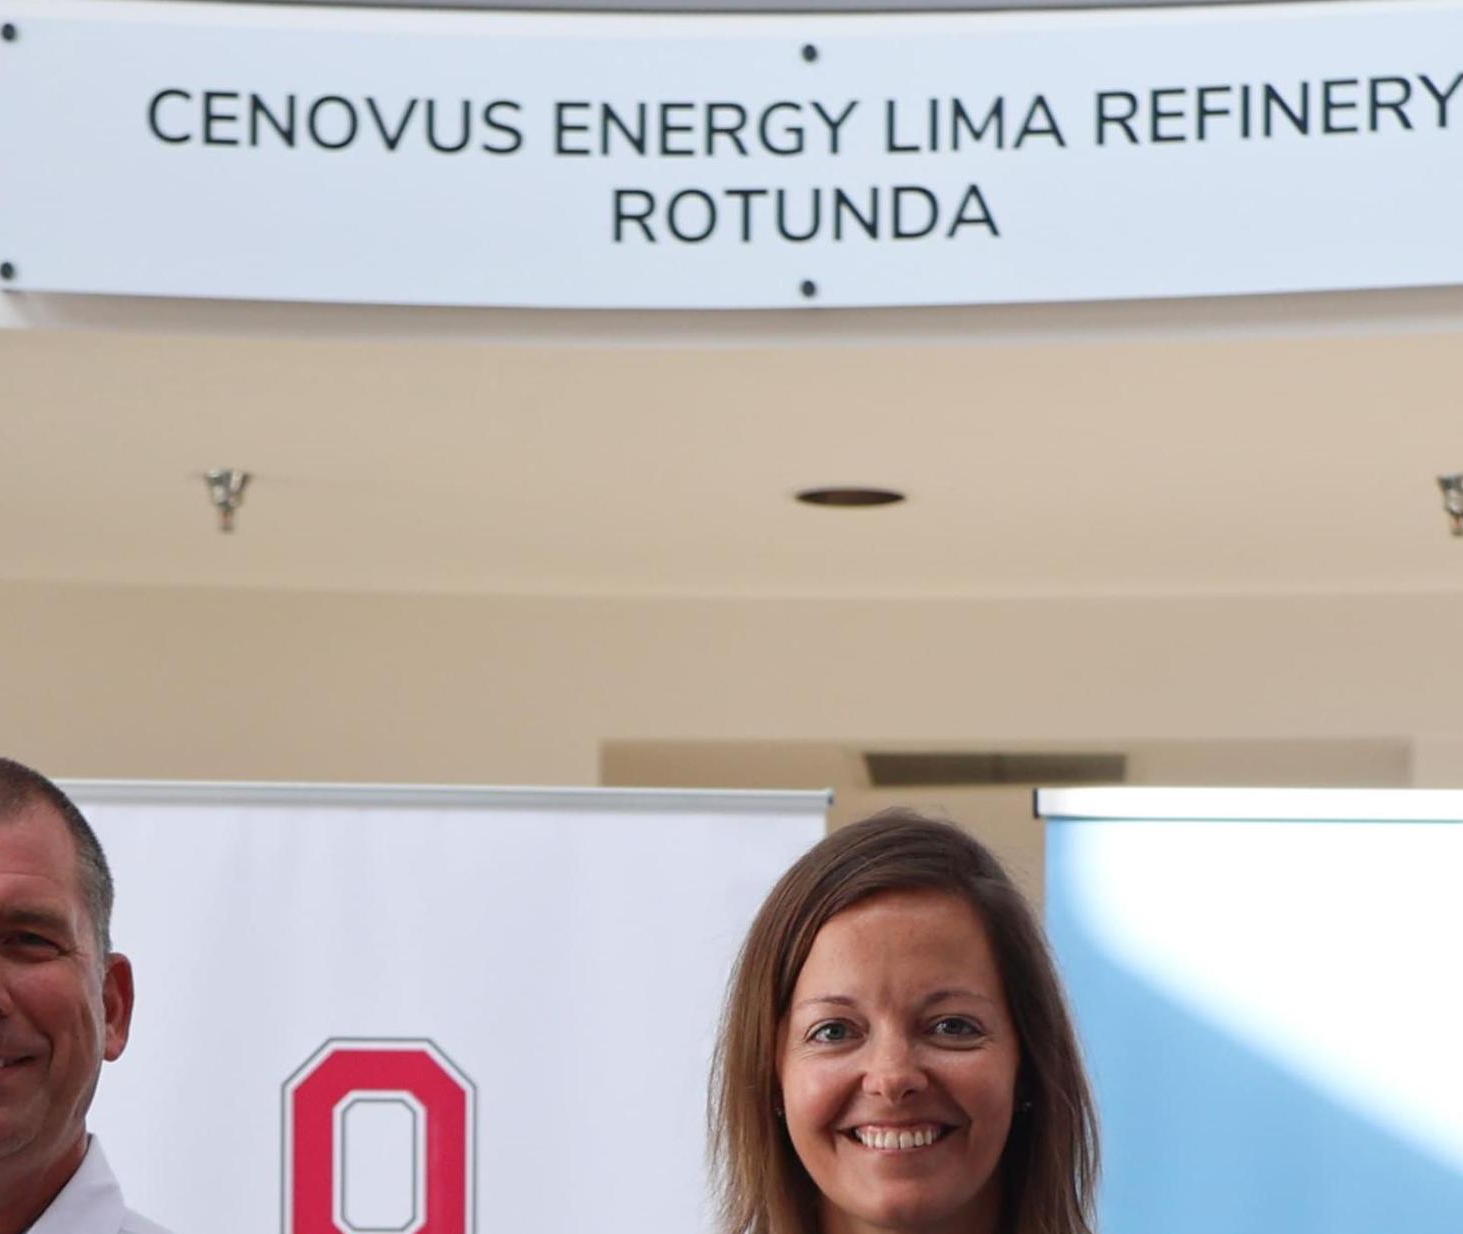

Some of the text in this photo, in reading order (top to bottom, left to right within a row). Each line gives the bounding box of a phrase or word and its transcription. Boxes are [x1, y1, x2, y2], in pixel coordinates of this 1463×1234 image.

[148, 89, 522, 154] CENOVUS
[555, 101, 857, 156] ENERGY
[887, 95, 1065, 152] LIMA
[614, 185, 999, 243] ROTUNDA
